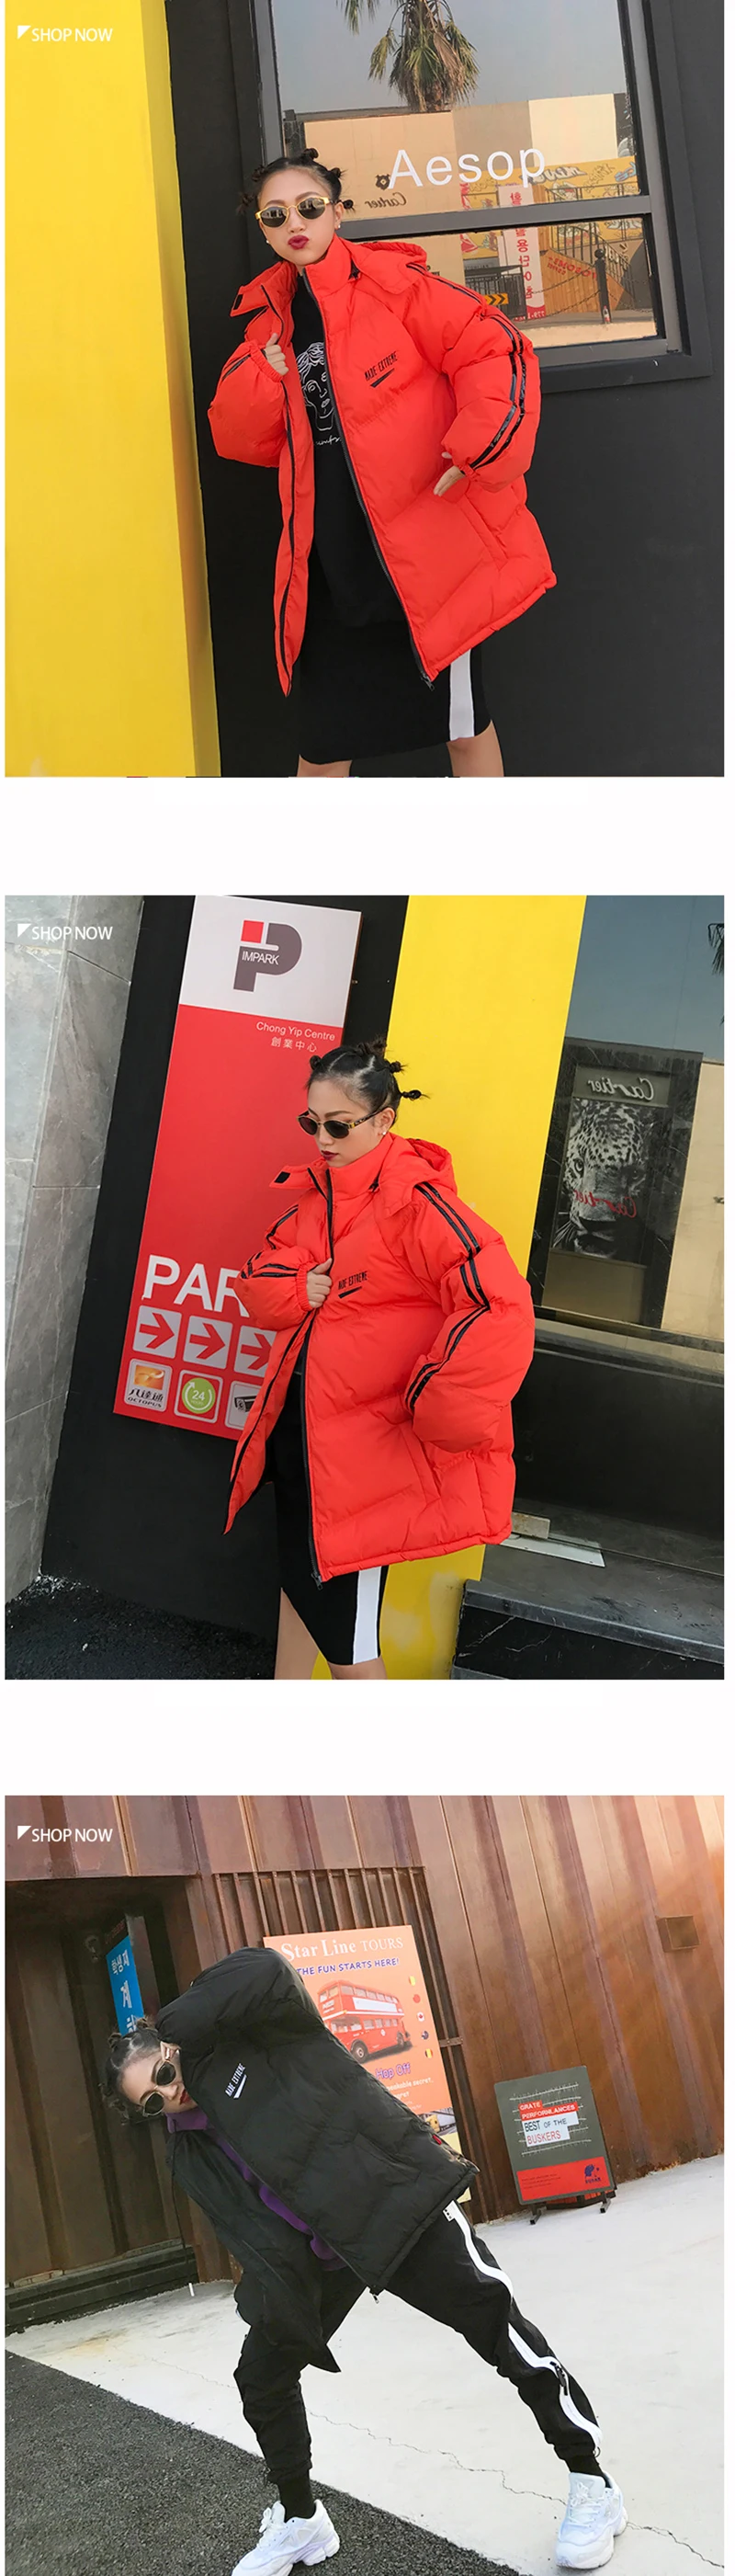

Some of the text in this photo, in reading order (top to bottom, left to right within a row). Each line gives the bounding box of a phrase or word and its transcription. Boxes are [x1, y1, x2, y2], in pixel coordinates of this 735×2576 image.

[388, 147, 546, 189] Aesop
[378, 350, 398, 372] EXTREME
[242, 951, 279, 965] IMPARK
[256, 1021, 335, 1041] Chong Yip Centre
[271, 1036, 317, 1053] 創業中心
[141, 1254, 250, 1318] PAR
[127, 1396, 162, 1408] OCTOPUS
[191, 1389, 206, 1401] 24
[280, 1937, 404, 1962] Star Line TOURS
[296, 1957, 400, 1976] THE FUN STARTS HERE!
[232, 2062, 246, 2084] EXTREME
[375, 2062, 411, 2080] Hop Off
[519, 2102, 541, 2111] GRATE
[524, 2120, 540, 2132] BEST
[526, 2130, 561, 2145] BUSKERS
